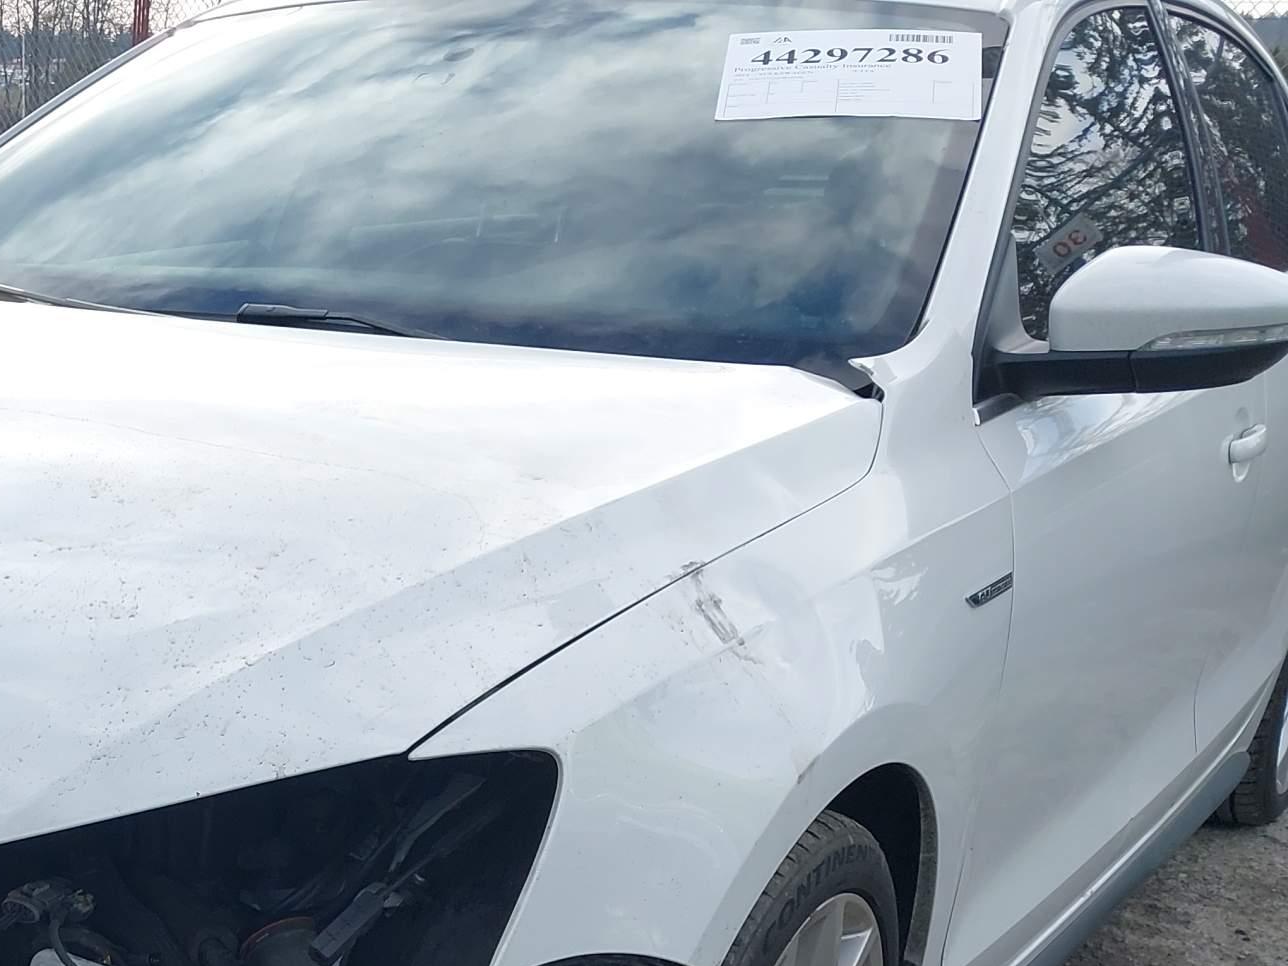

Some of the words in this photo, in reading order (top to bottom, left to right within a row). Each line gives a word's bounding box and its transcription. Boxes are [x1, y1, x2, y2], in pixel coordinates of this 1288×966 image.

[750, 47, 950, 65] 44297286
[734, 65, 792, 73] Progressive
[794, 63, 839, 71] Casualty
